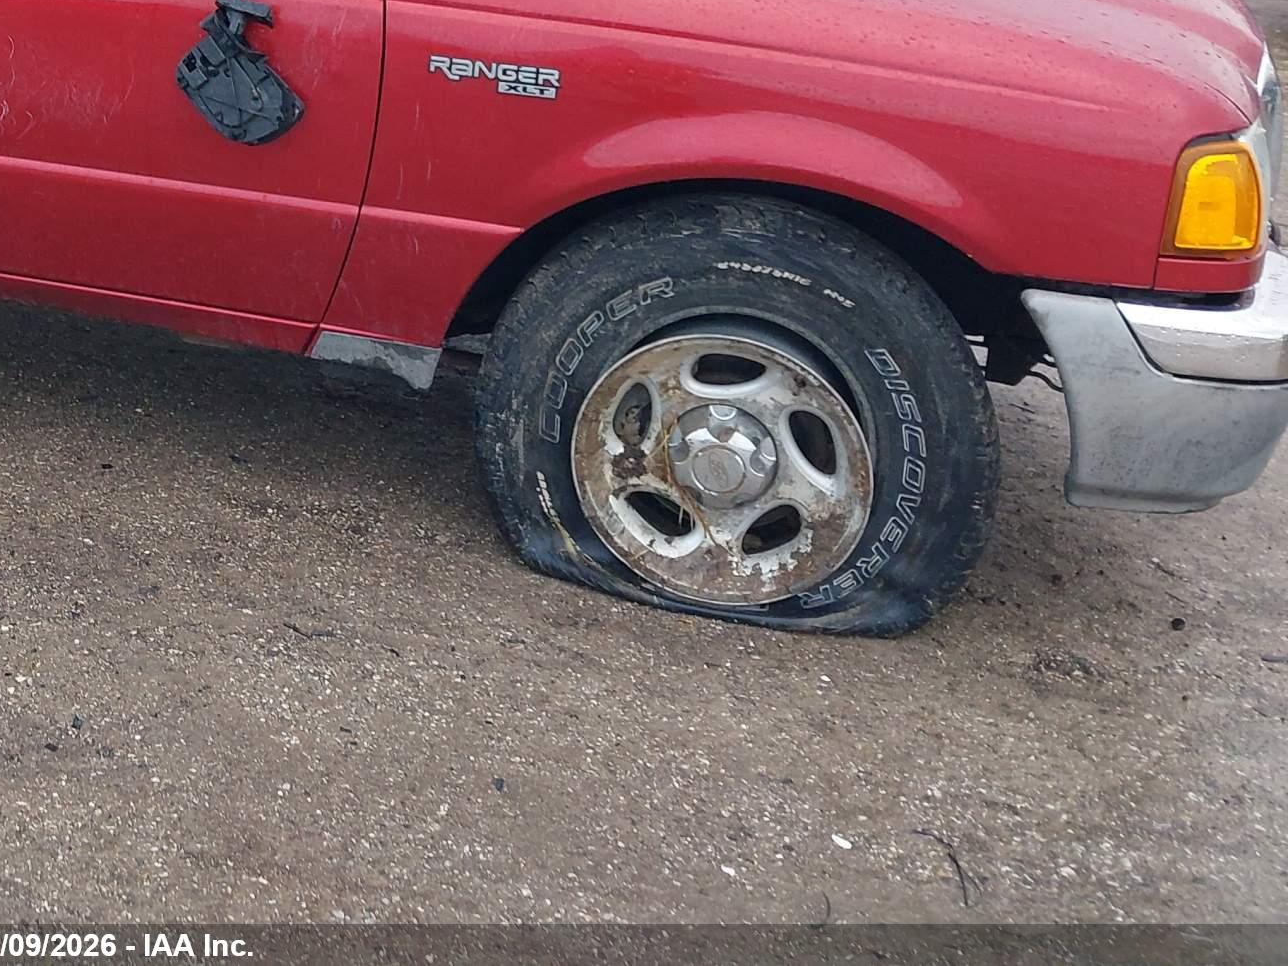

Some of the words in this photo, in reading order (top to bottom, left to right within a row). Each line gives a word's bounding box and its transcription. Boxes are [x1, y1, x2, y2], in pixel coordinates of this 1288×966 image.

[428, 55, 561, 87] RANGER
[539, 277, 674, 443] COOPER
[796, 348, 927, 608] DISCOVERER
